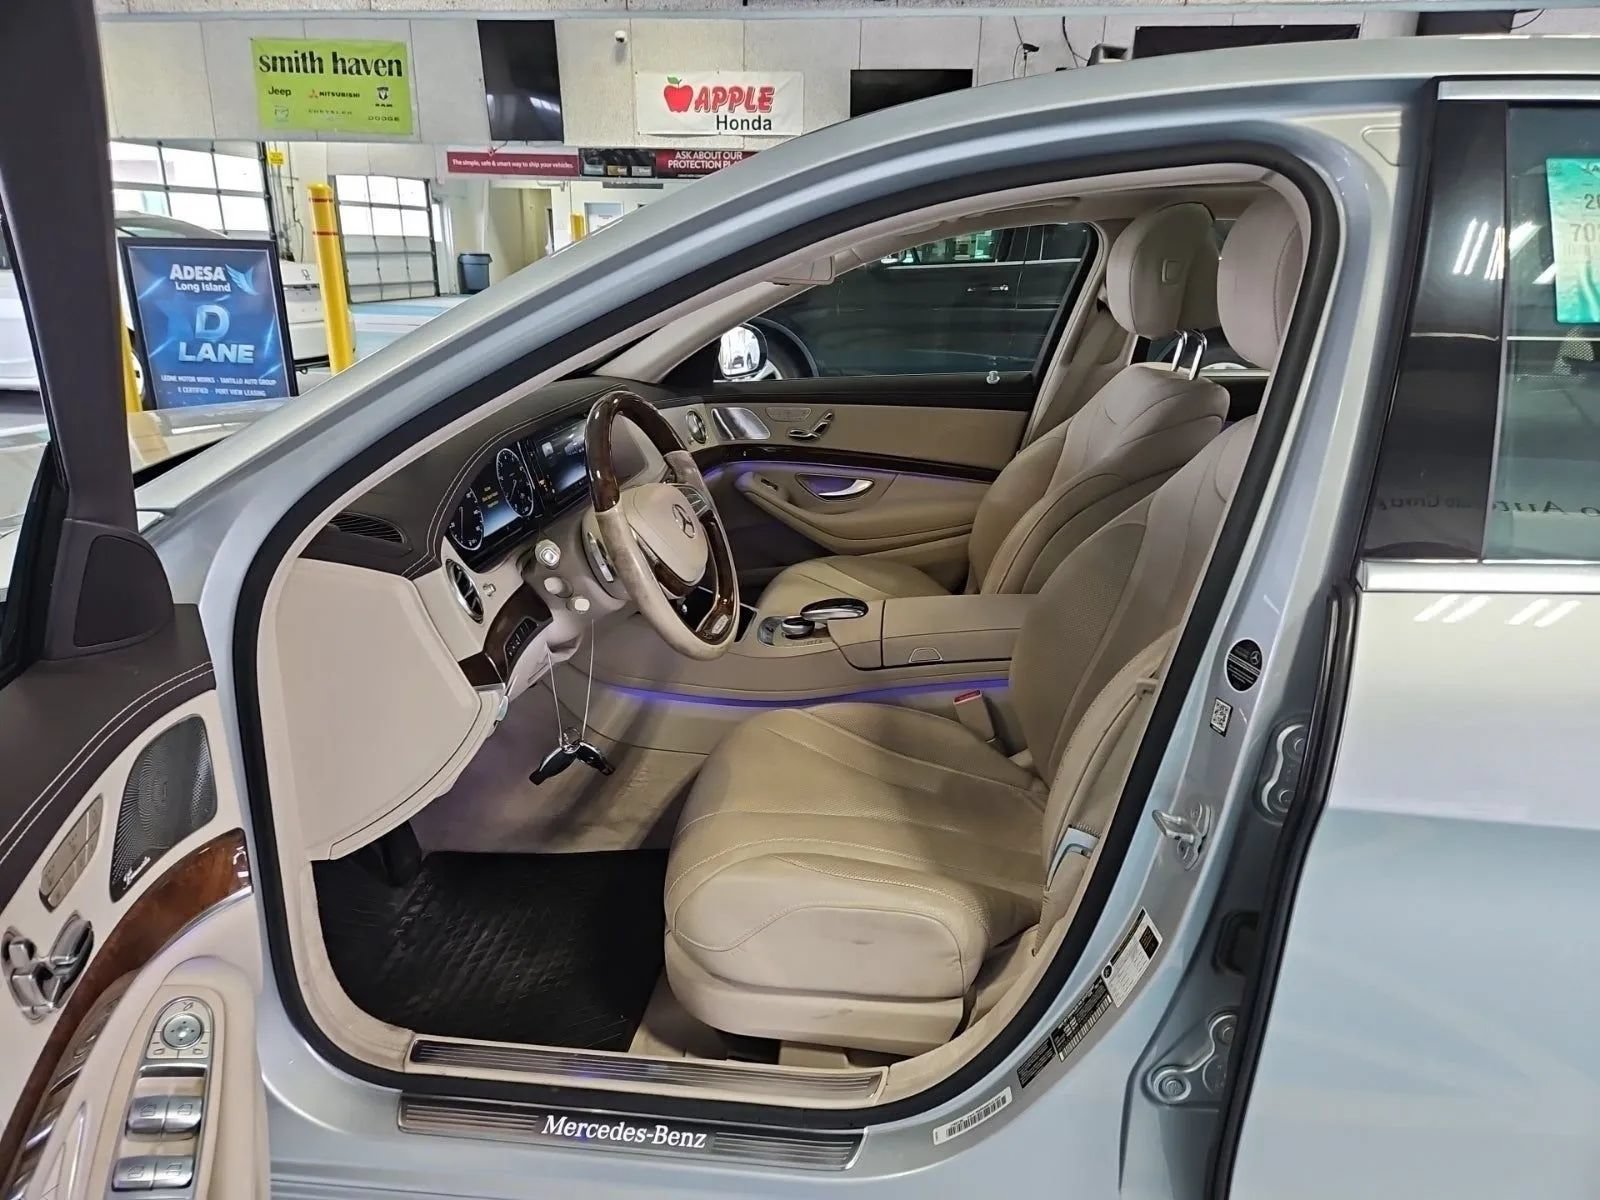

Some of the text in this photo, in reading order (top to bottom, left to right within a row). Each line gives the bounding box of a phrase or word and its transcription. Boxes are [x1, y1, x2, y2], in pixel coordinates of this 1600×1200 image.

[259, 50, 403, 77] smith haven
[268, 86, 292, 97] Jeep
[693, 86, 775, 114] APPLE
[716, 114, 773, 131] Honda
[452, 158, 462, 166] The
[528, 161, 539, 169] ship
[667, 160, 722, 169] PROTECTION
[675, 151, 743, 160] ASK ABOUT OUR
[169, 263, 227, 282] ADESA
[174, 281, 232, 293] Long Island
[195, 304, 231, 341] D
[178, 342, 255, 364] LANE
[541, 1115, 707, 1149] Mercedes-Benz
